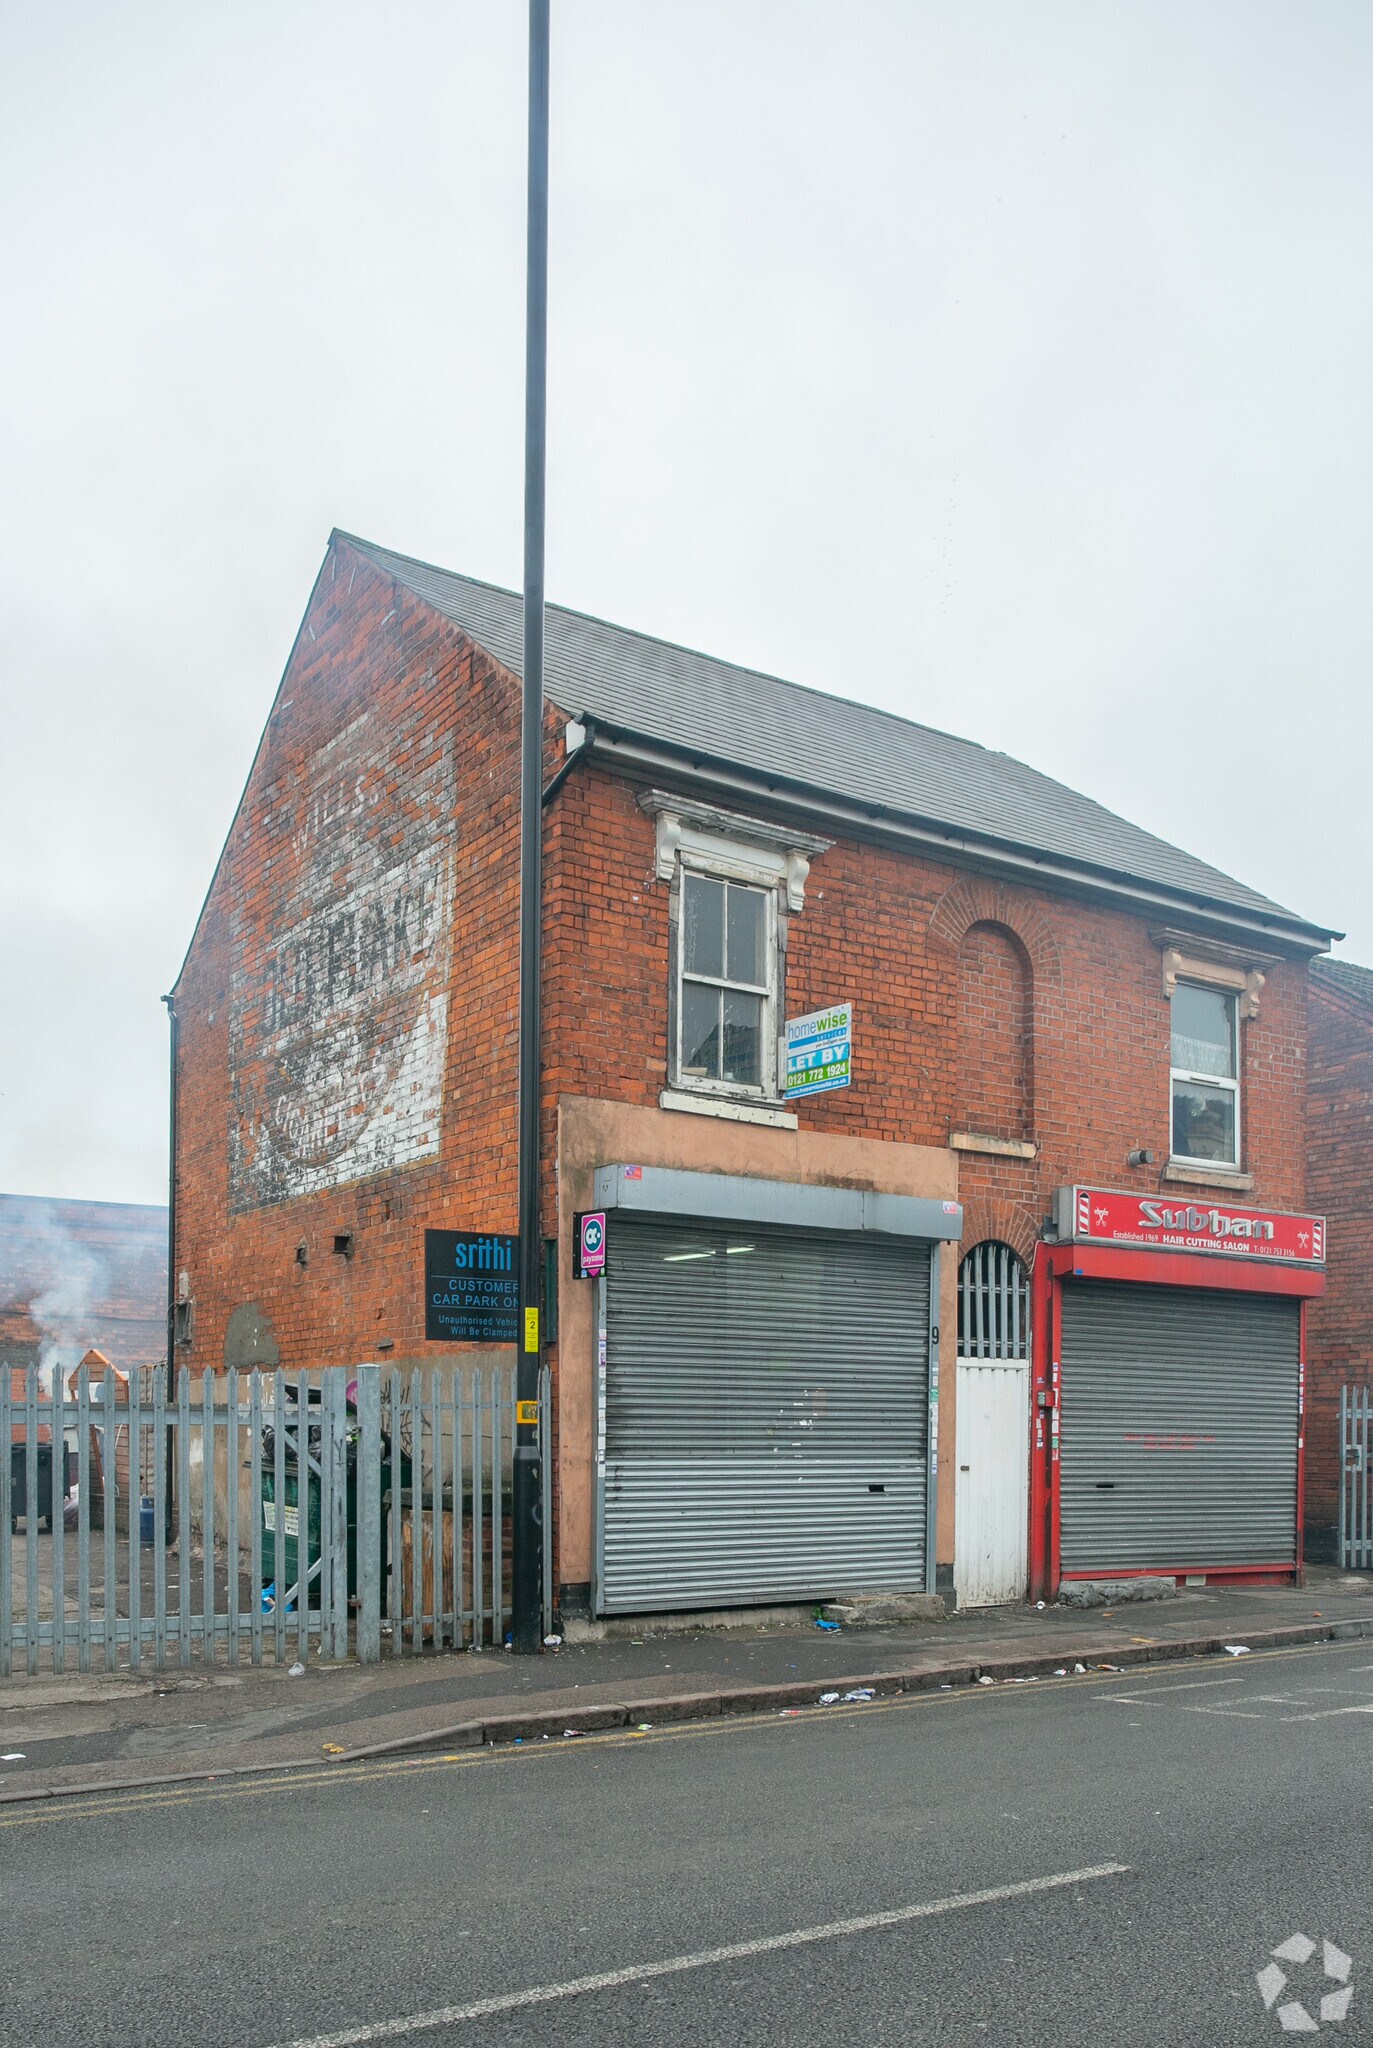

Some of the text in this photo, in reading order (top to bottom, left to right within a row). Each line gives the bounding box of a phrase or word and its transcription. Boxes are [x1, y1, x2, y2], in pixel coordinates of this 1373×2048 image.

[788, 1012, 847, 1039] homewise
[788, 1045, 847, 1073] LET BY
[788, 1063, 846, 1086] 0121 772 1924
[1138, 1200, 1275, 1241] Subhan
[455, 1237, 512, 1271] srithi
[1113, 1230, 1144, 1242] Established
[1145, 1233, 1159, 1243] 1969
[1163, 1233, 1185, 1246] HAIR
[1186, 1236, 1222, 1250] CUTTING
[1223, 1240, 1250, 1252] SALON
[1260, 1245, 1272, 1254] 0121
[1273, 1247, 1282, 1256] 753
[1283, 1248, 1295, 1257] 3156
[582, 1254, 604, 1266] payzone
[433, 1293, 460, 1305] CAR
[465, 1295, 499, 1307] PARK
[438, 1315, 493, 1326] Unauthorised
[530, 1321, 536, 1329] 2
[450, 1326, 518, 1338] Will Be Clamped
[931, 1326, 940, 1345] 9
